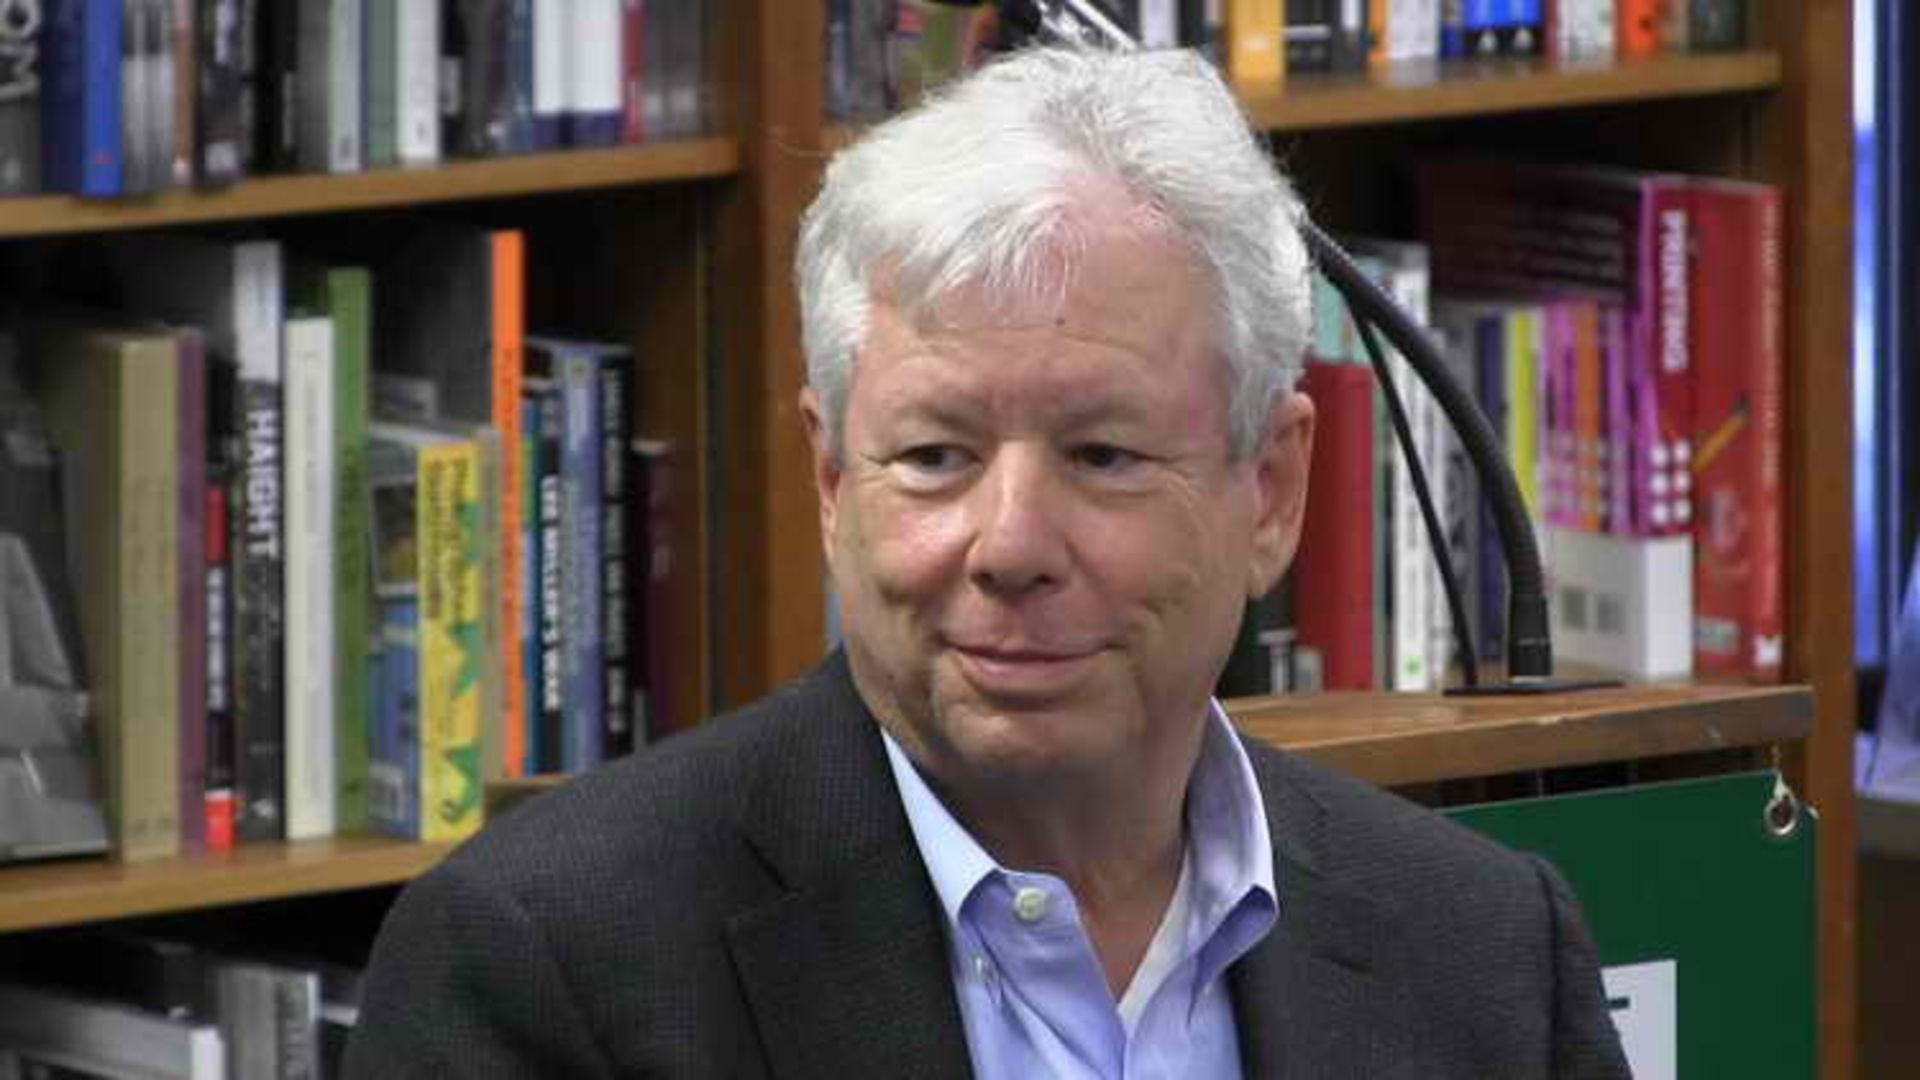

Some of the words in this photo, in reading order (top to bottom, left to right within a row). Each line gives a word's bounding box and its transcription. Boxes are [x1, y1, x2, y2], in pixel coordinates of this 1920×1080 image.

[1660, 210, 1689, 373] PRINTING
[246, 409, 278, 559] HAIGHT
[543, 646, 564, 711] WAR
